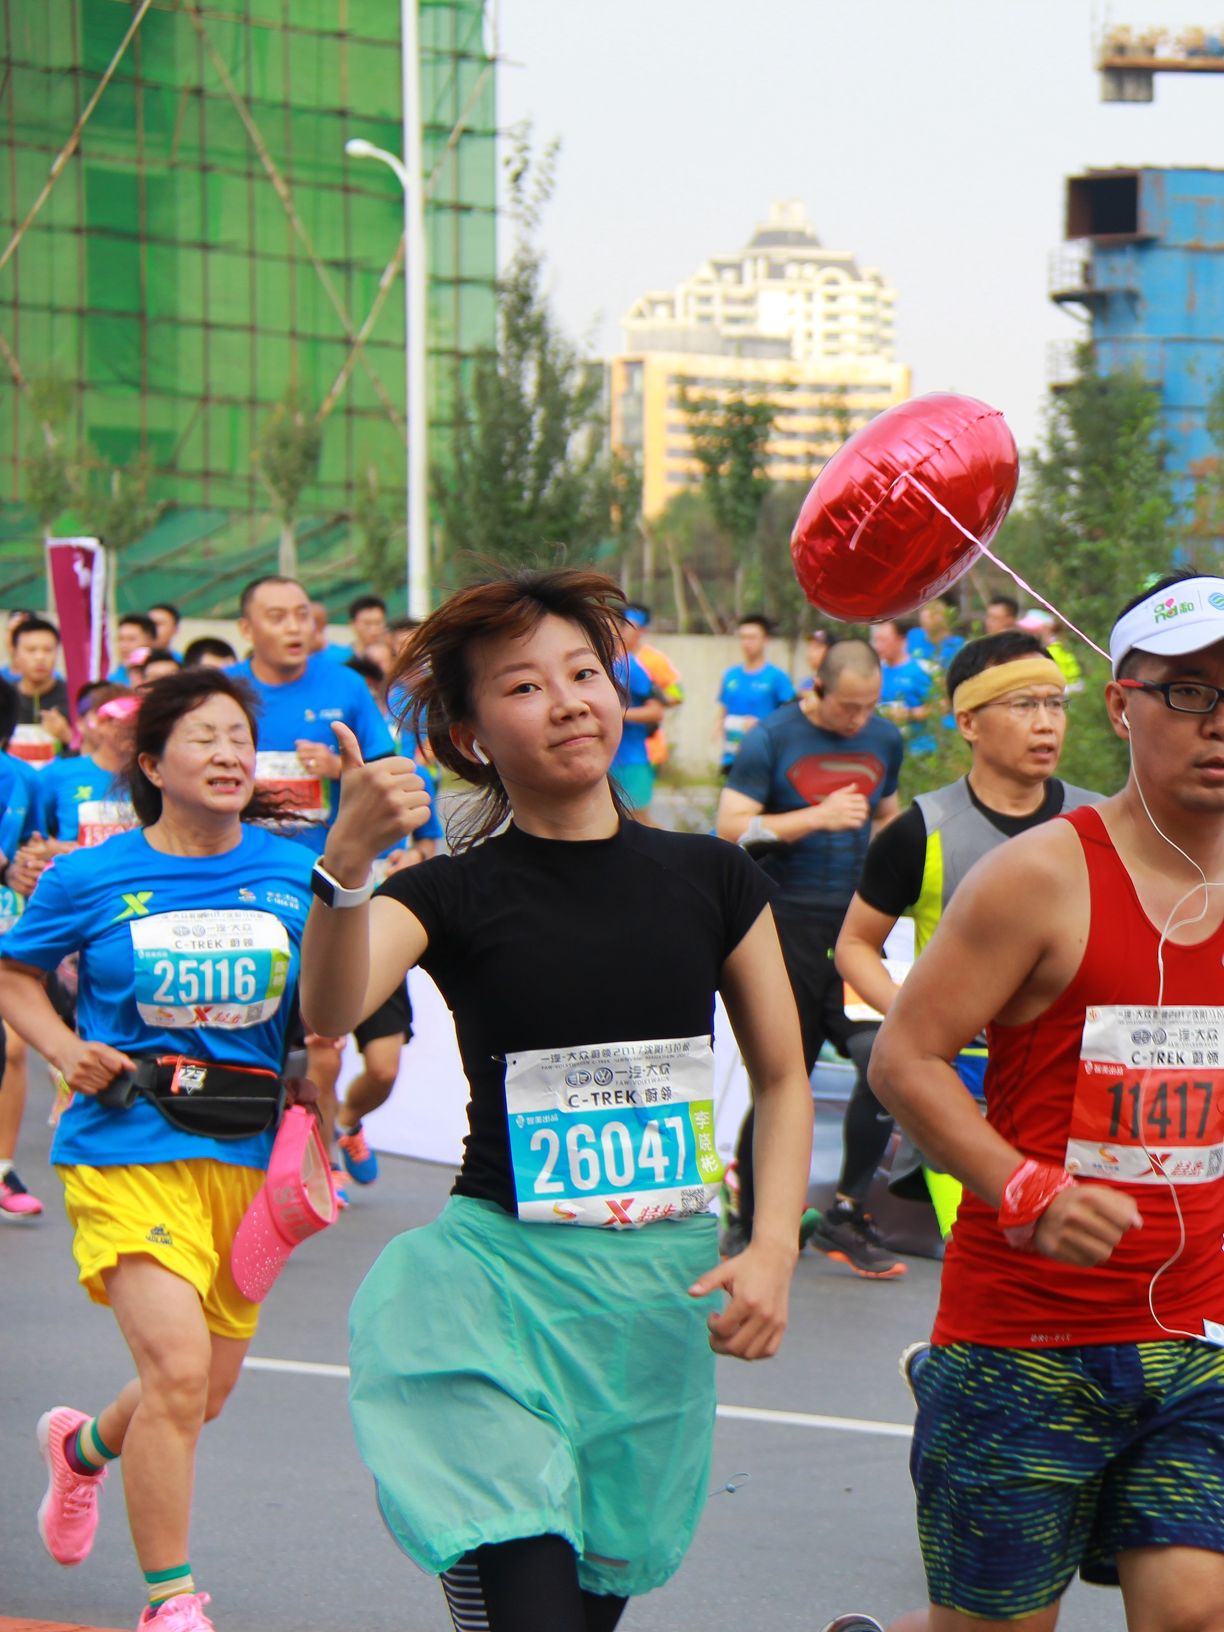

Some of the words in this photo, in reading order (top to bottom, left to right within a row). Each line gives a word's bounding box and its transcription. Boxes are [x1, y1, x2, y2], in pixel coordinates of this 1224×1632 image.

[153, 957, 257, 1003] 25116
[567, 1089, 637, 1108] C-TREK
[645, 1086, 673, 1104] 蔚领
[1107, 1081, 1214, 1139] 11417
[530, 1115, 686, 1194] 26047
